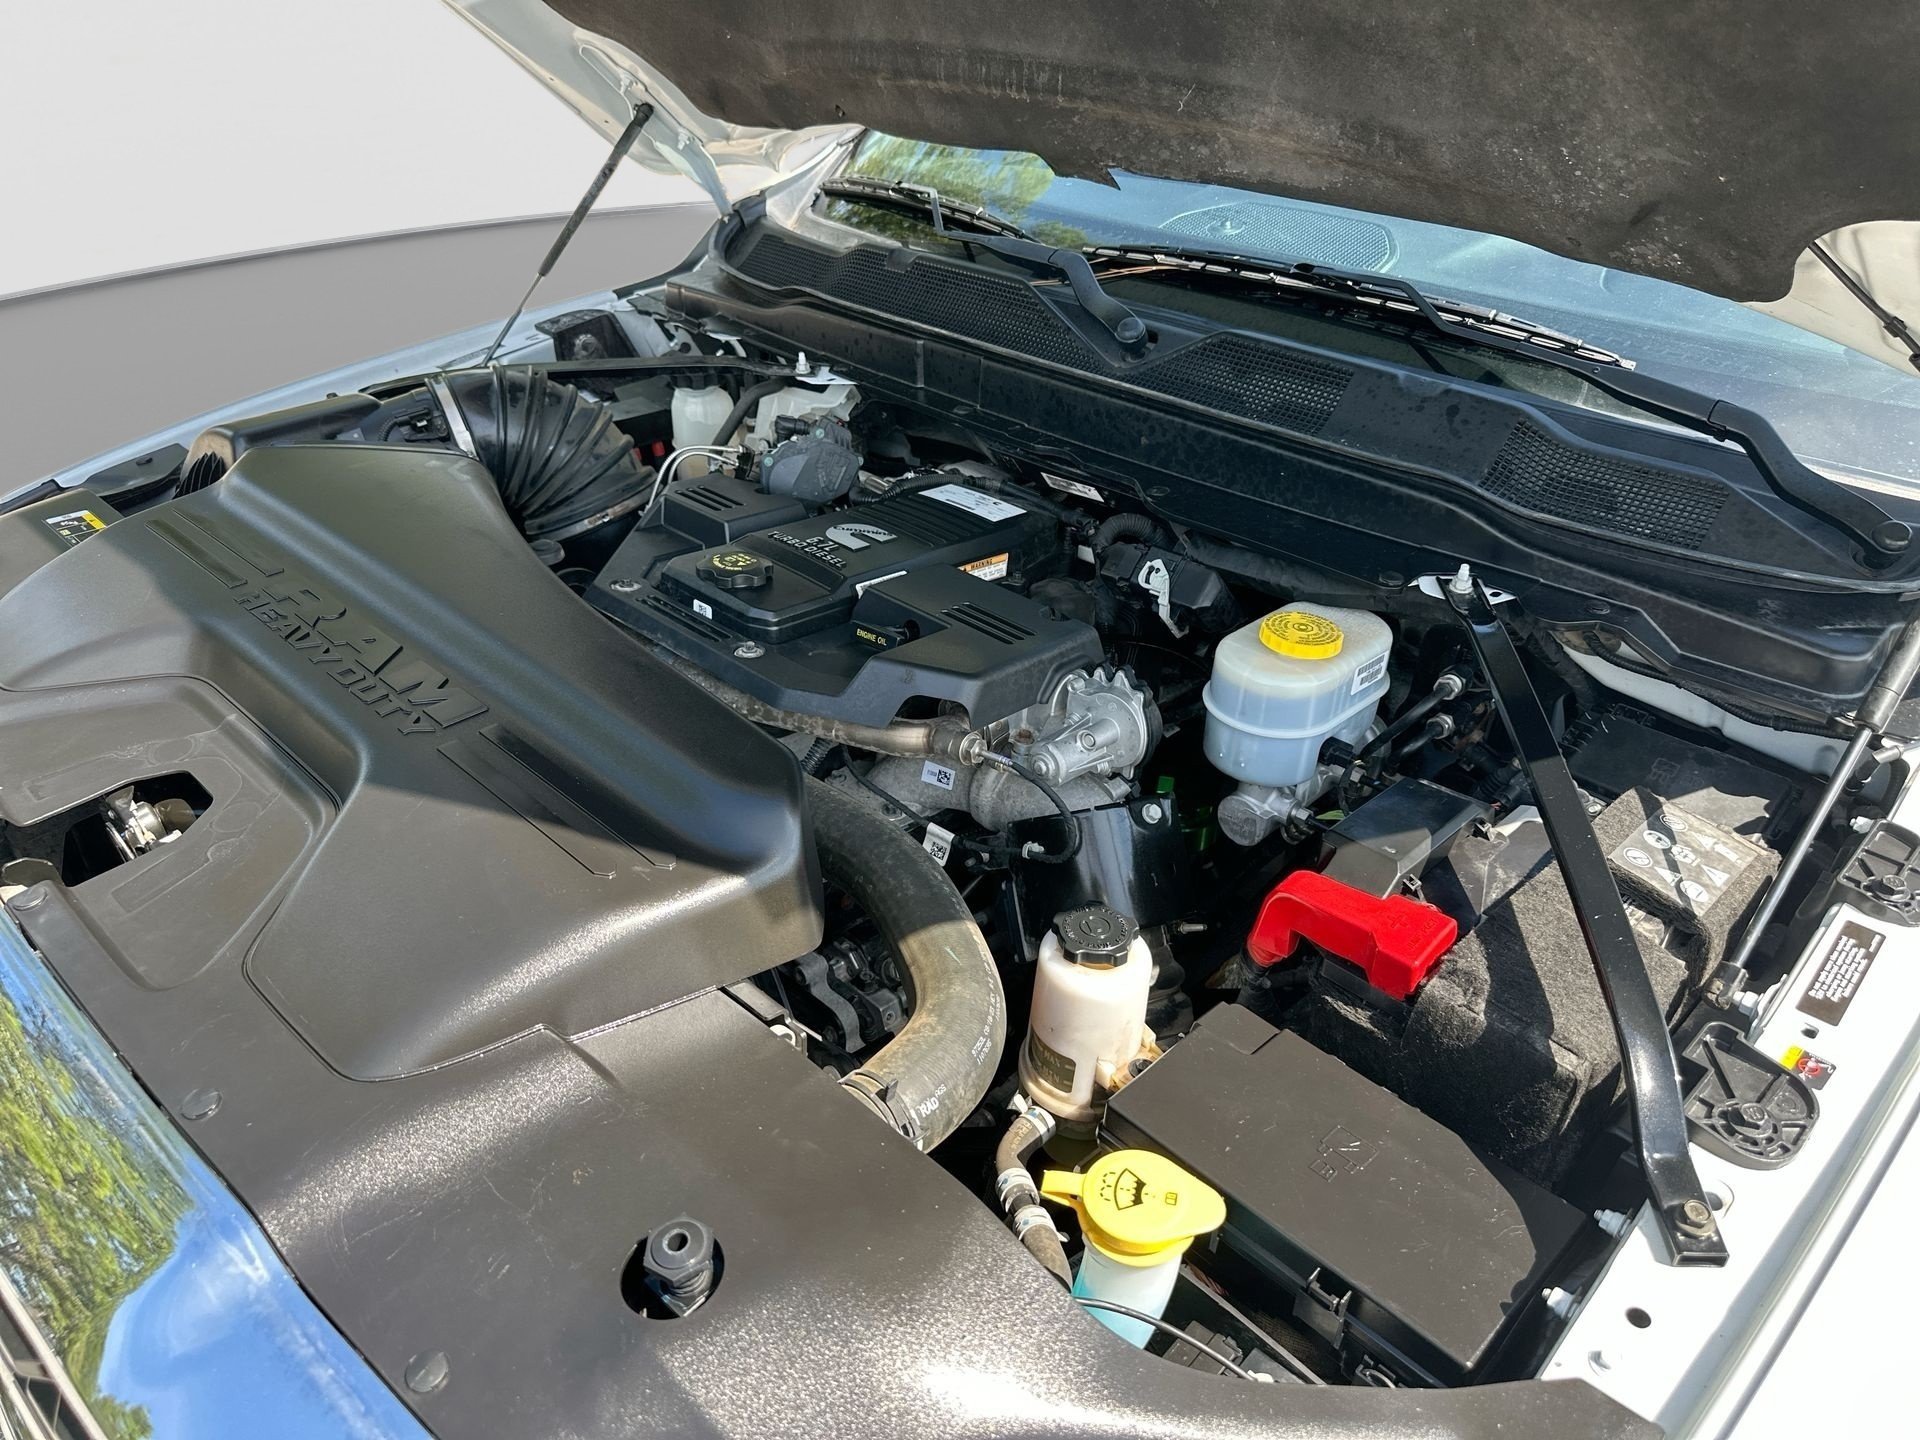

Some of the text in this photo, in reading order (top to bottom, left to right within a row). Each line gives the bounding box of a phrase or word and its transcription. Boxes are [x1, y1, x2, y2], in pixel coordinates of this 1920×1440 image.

[767, 531, 847, 571] TURBO DIESEL
[806, 536, 840, 552] 6.7L
[970, 558, 993, 569] WARNING
[856, 628, 887, 646] ENGINE OIL
[233, 592, 436, 736] HEAVY DUTY
[262, 578, 490, 729] RAM
